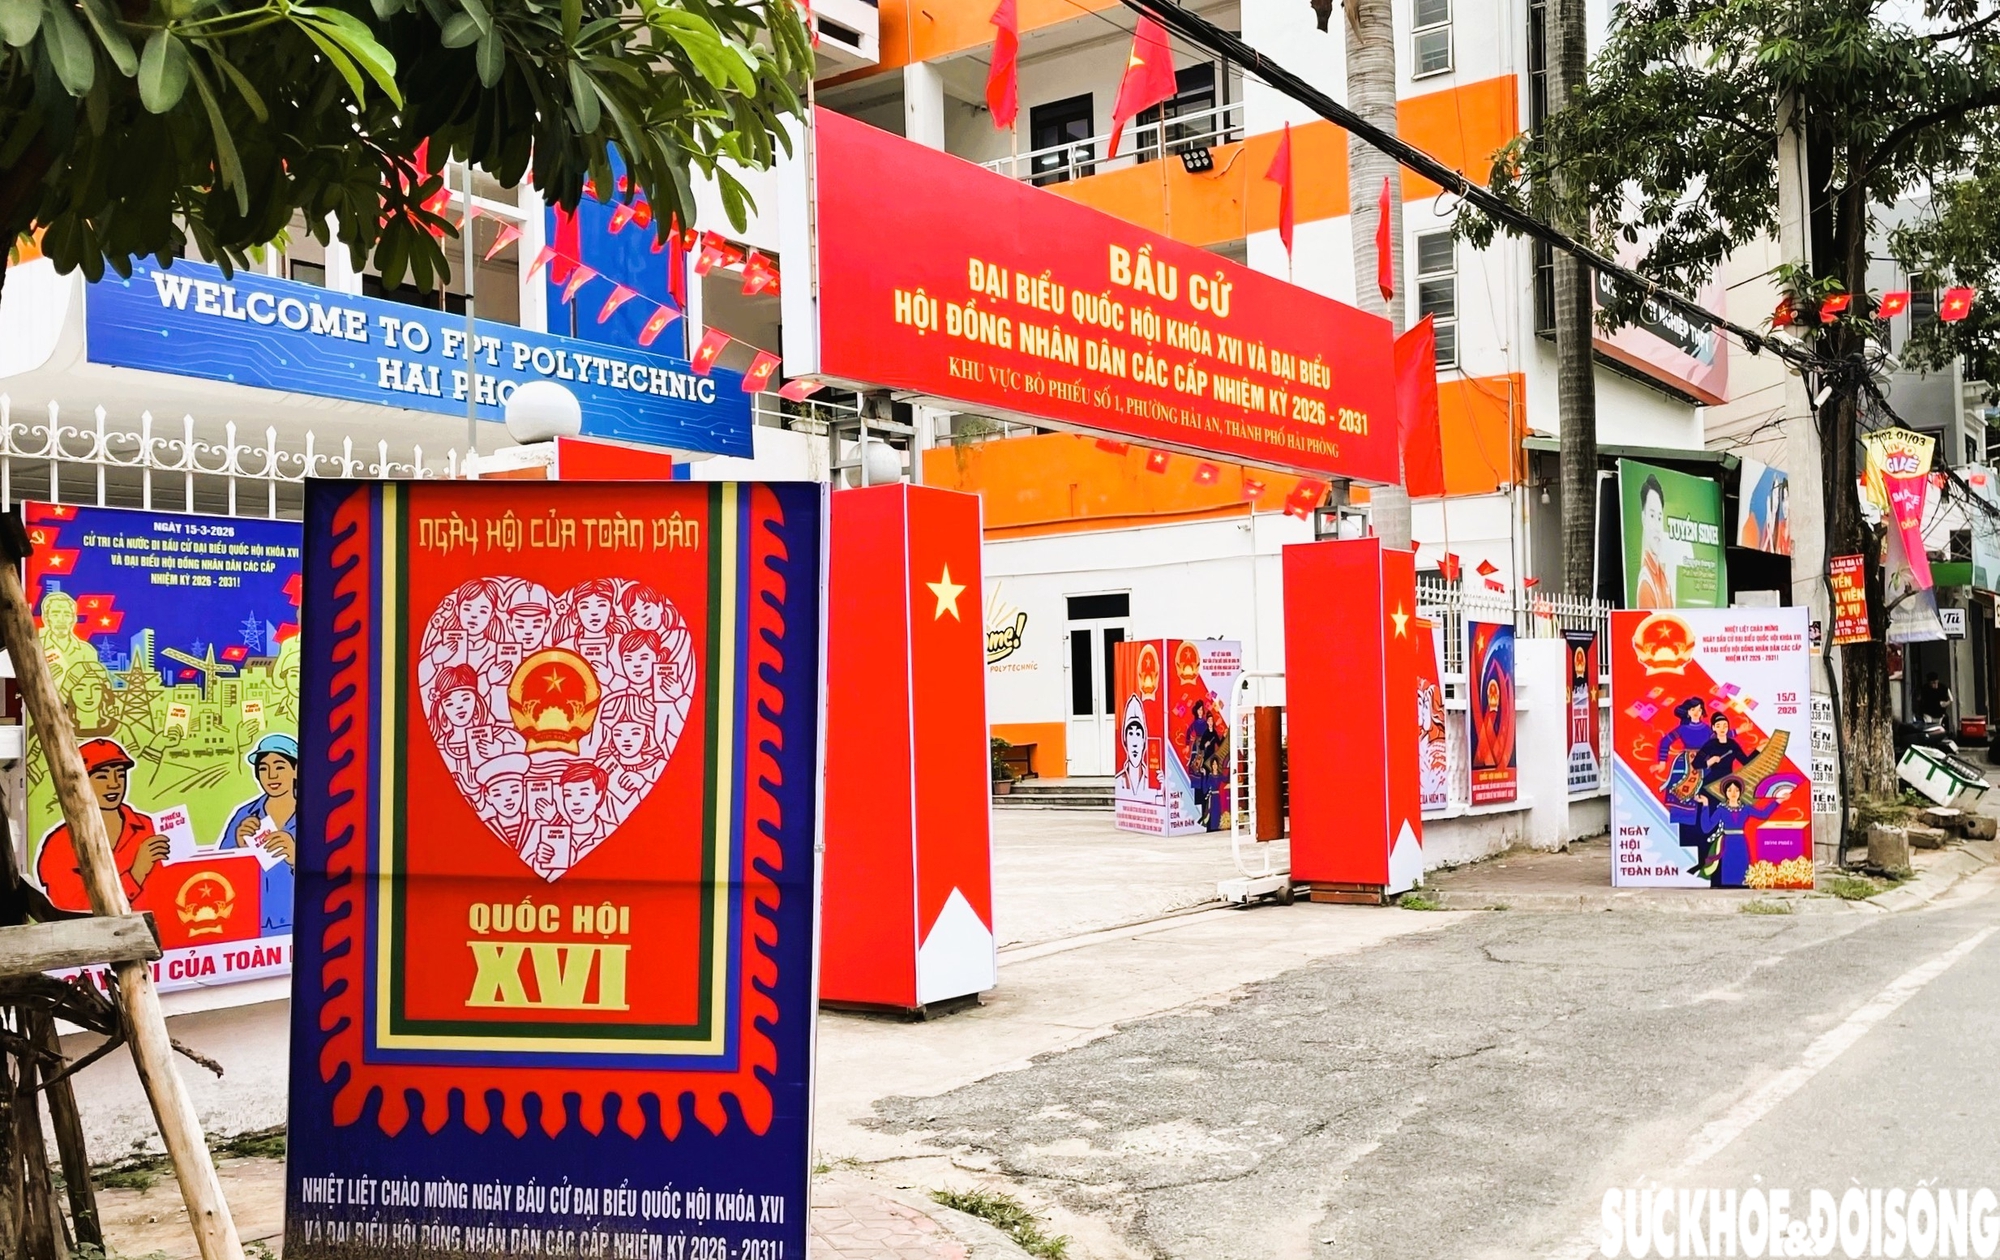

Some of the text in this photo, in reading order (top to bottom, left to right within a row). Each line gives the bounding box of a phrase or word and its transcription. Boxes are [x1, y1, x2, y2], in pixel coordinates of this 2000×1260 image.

[1109, 243, 1233, 318] BẦU CỬ
[150, 271, 716, 404] WELCOME TO FPT POLYTECHNIC
[968, 257, 1331, 390] ĐẠI BIỂU QUỐC HỘI KHÓA XVI VÀ ĐẠI BIỂU
[377, 357, 441, 396] HAI
[895, 287, 938, 336] HỘI
[946, 298, 1012, 350] ĐỒNG
[1019, 322, 1079, 367] NHÂN
[1086, 338, 1126, 378] DÂN
[1132, 351, 1168, 388] CÁC
[1173, 358, 1208, 397] CẤP
[1213, 374, 1264, 413] NHIỆM
[1269, 387, 1288, 417] KỲ
[1292, 395, 1325, 426] 2026
[1338, 407, 1368, 436] 2031
[949, 356, 1339, 458] KHU VỰC BỎ PHIẾU SỐ 1, PHƯỜNG HẢI AN, THÀNH PHỐ HẢI PHÒNG
[1896, 431, 1926, 446] 01/03
[153, 521, 235, 537] NGÀY 15-3-2026
[419, 508, 699, 557] NGÀY HỘI CỦA TOÀN DÂN
[1943, 612, 1961, 624] Tú
[1777, 692, 1796, 702] 15/3
[1777, 706, 1797, 715] 2026
[1574, 718, 1588, 743] XVI
[160, 811, 181, 823] PHIẾU
[1619, 825, 1650, 836] NGÀY
[1620, 839, 1640, 851] HỘI
[1620, 851, 1643, 863] CỦA
[1620, 865, 1651, 876] TOÀN
[468, 894, 630, 939] QUỐC HỘI
[168, 950, 216, 979] CỦA
[223, 945, 282, 971] TOÀN
[465, 940, 632, 1011] XVI
[302, 1172, 785, 1226] NHIỆT LIỆT CHÀO MỪNG NGÀY BẦU CỬ ĐẠI BIỂU QUỐC HỘI KHÓA XVI
[304, 1215, 321, 1245] VÀ
[327, 1220, 349, 1246] ĐẠI
[355, 1210, 387, 1248] BIỂU
[392, 1218, 417, 1250] HỘI
[421, 1216, 461, 1251] ĐỒNG
[465, 1221, 506, 1252] NHÂN
[510, 1223, 541, 1255] DÂN
[545, 1225, 575, 1257] CÁC
[579, 1223, 609, 1259] CẤP
[613, 1228, 663, 1260] NHIỆM
[667, 1230, 687, 1260] KỲ
[690, 1236, 726, 1260] 2026
